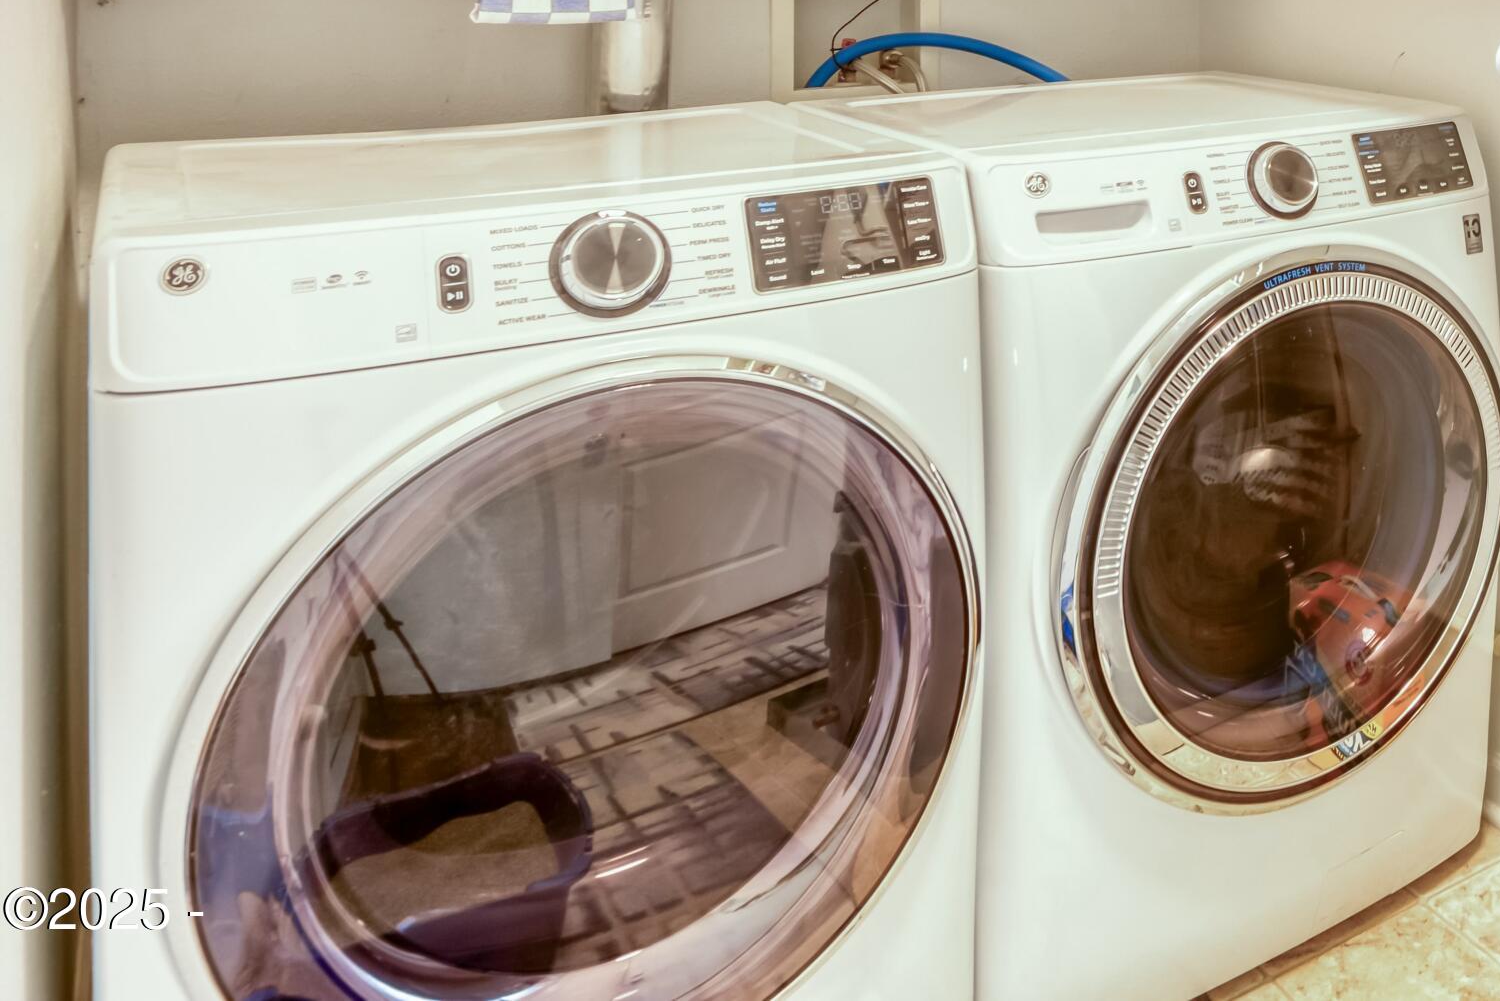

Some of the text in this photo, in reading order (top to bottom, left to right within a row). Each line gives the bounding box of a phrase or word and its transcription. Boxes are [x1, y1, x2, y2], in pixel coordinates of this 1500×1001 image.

[514, 224, 538, 232] LOADS
[692, 219, 727, 228] DELICATES
[491, 242, 526, 252] COTTONS
[492, 261, 523, 269] TOWELS
[705, 268, 734, 276] REFRESH
[1263, 261, 1367, 290] ULTRAFRESH VENT SYSTEM
[494, 278, 518, 286] BULKY
[495, 297, 529, 307] SANITIZE
[498, 317, 525, 326] ACTIVE
